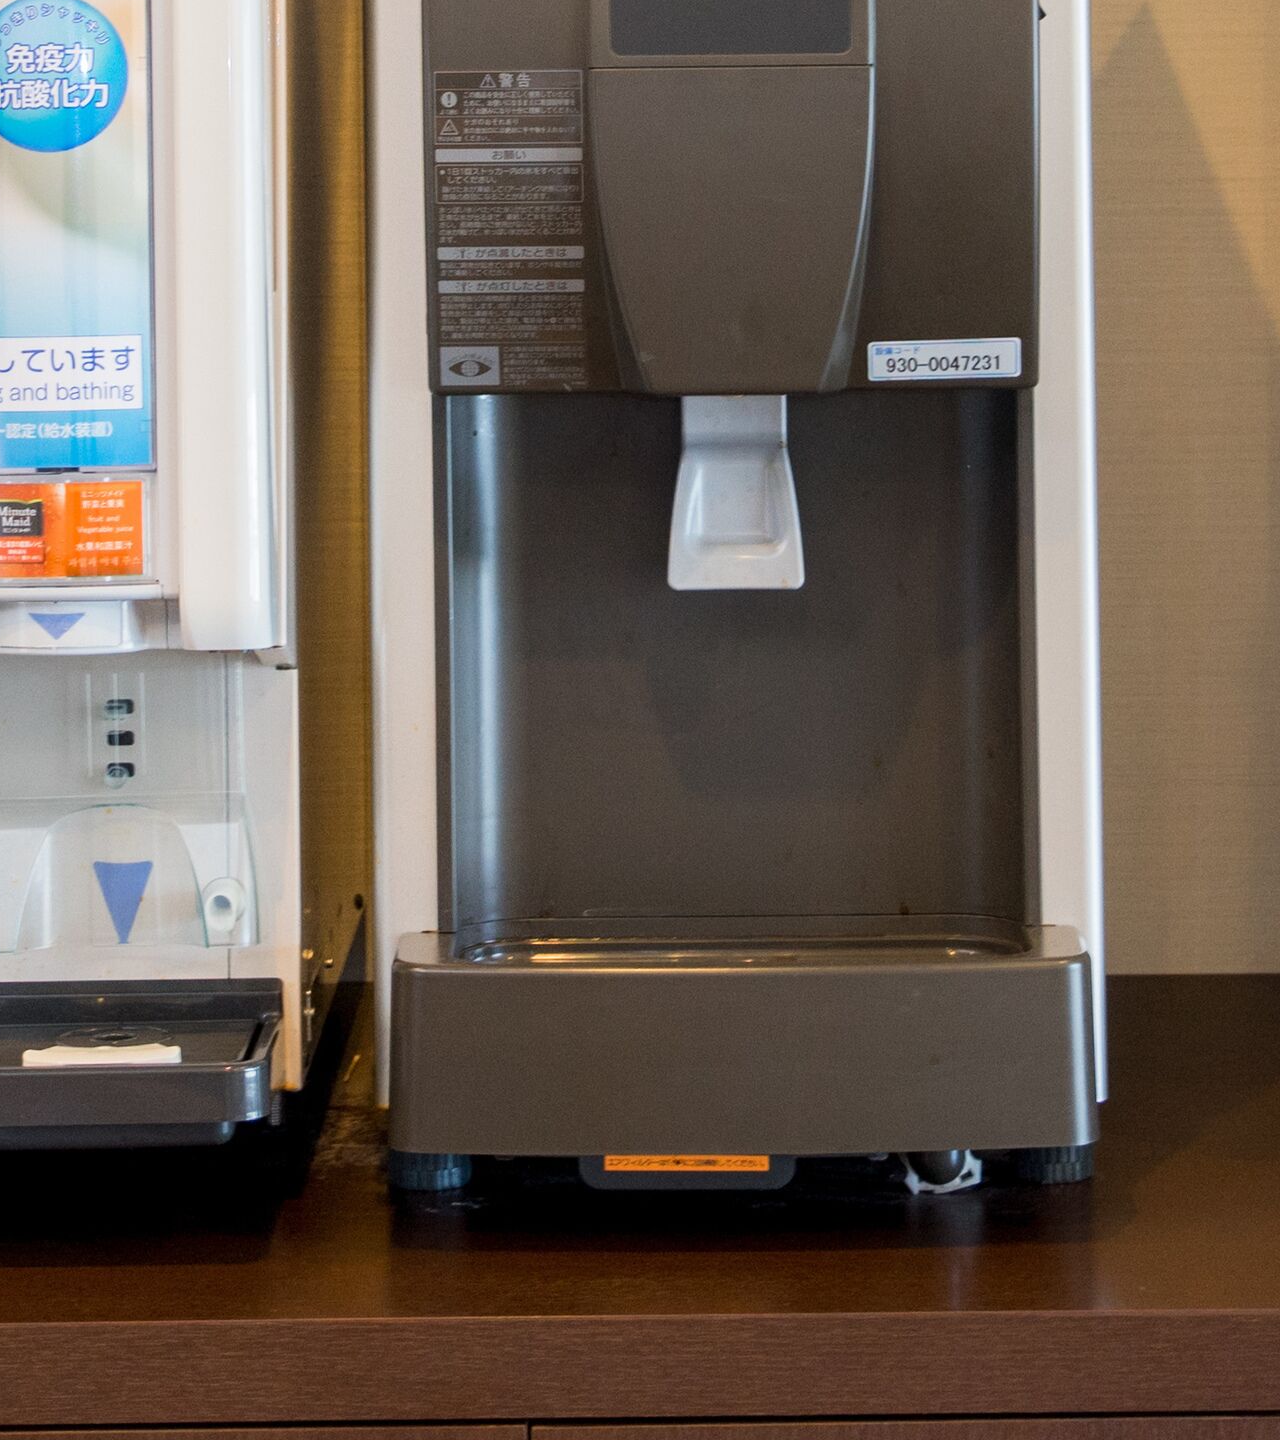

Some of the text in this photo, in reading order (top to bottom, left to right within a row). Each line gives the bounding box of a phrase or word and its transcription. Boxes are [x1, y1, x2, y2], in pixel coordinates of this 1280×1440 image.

[5, 42, 95, 74] 免疫力
[498, 73, 531, 88] 警告
[886, 355, 1001, 373] 930-0047231
[10, 382, 48, 401] and
[55, 380, 135, 404] bathing
[2, 517, 31, 527] Maid
